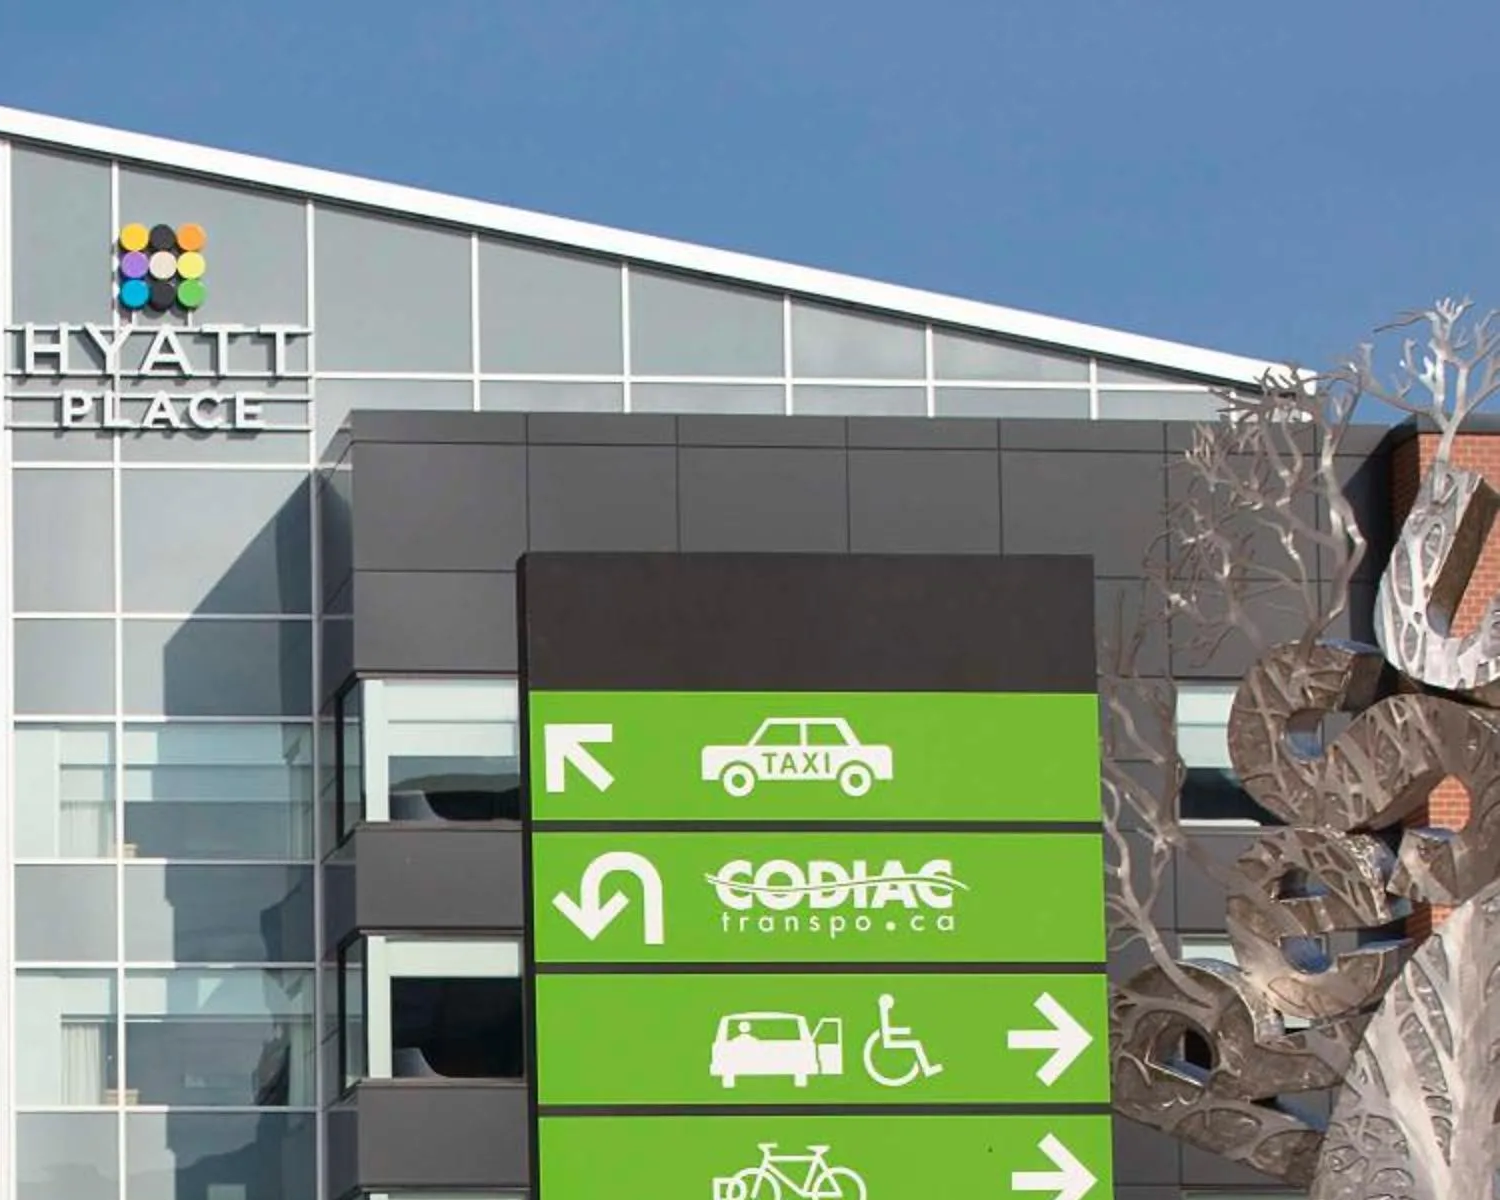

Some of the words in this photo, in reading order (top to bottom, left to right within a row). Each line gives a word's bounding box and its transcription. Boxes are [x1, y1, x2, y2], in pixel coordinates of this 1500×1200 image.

[24, 323, 300, 376] HYATT
[61, 390, 265, 429] PLACE
[761, 751, 831, 774] TAXI
[715, 859, 953, 910] CODIAC
